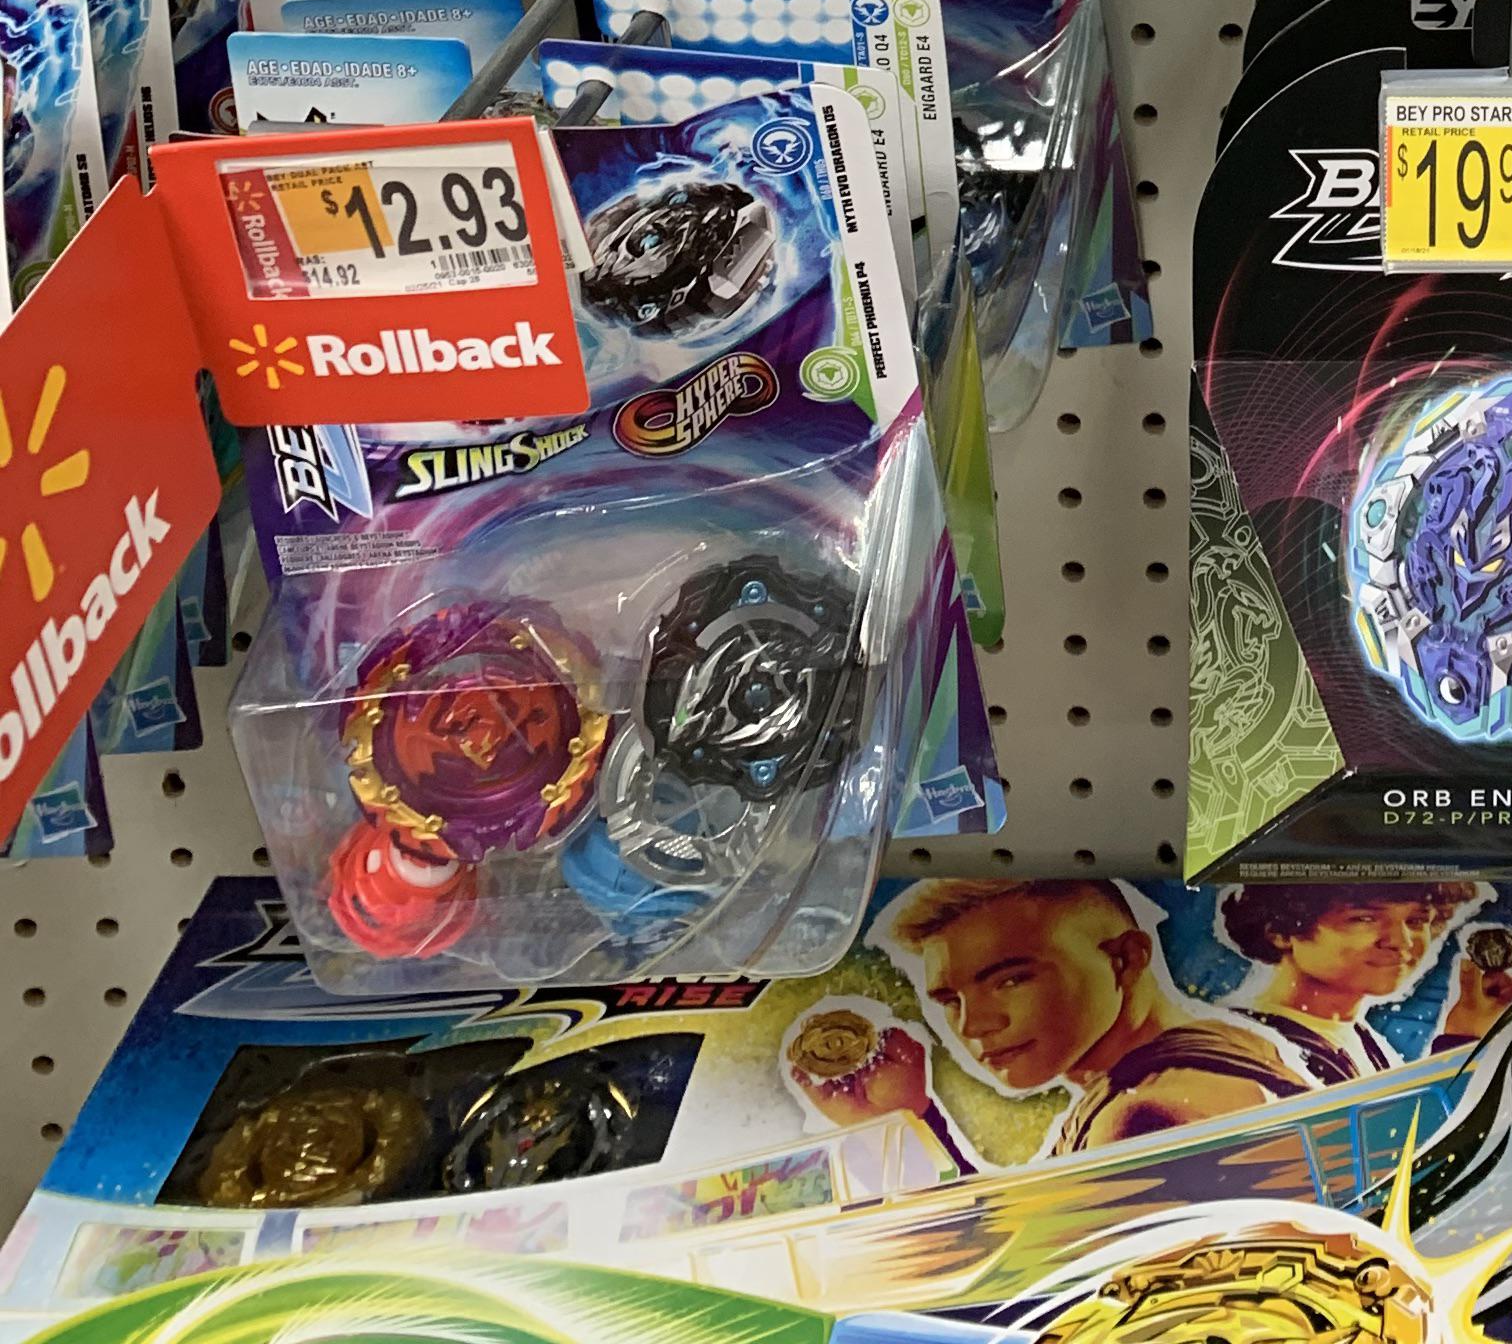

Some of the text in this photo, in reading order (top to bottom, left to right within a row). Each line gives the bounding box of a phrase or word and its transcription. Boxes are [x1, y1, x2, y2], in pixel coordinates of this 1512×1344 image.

[397, 63, 418, 79] 8+
[916, 35, 937, 120] ENGAARD E4
[1396, 106, 1427, 121] BEY
[1432, 106, 1465, 122] PRO
[1402, 128, 1440, 137] RETAIL
[1444, 128, 1476, 137] PRICE
[827, 124, 857, 233] MYTH EVO DRAGON
[306, 322, 562, 378] Rollback
[858, 278, 887, 379] PERFECT PHOENIX
[675, 356, 740, 423] HYPER
[675, 374, 744, 446] SPHERE
[0, 487, 171, 783] ollback
[1384, 789, 1453, 808] ORB
[612, 980, 757, 1011] RISE
